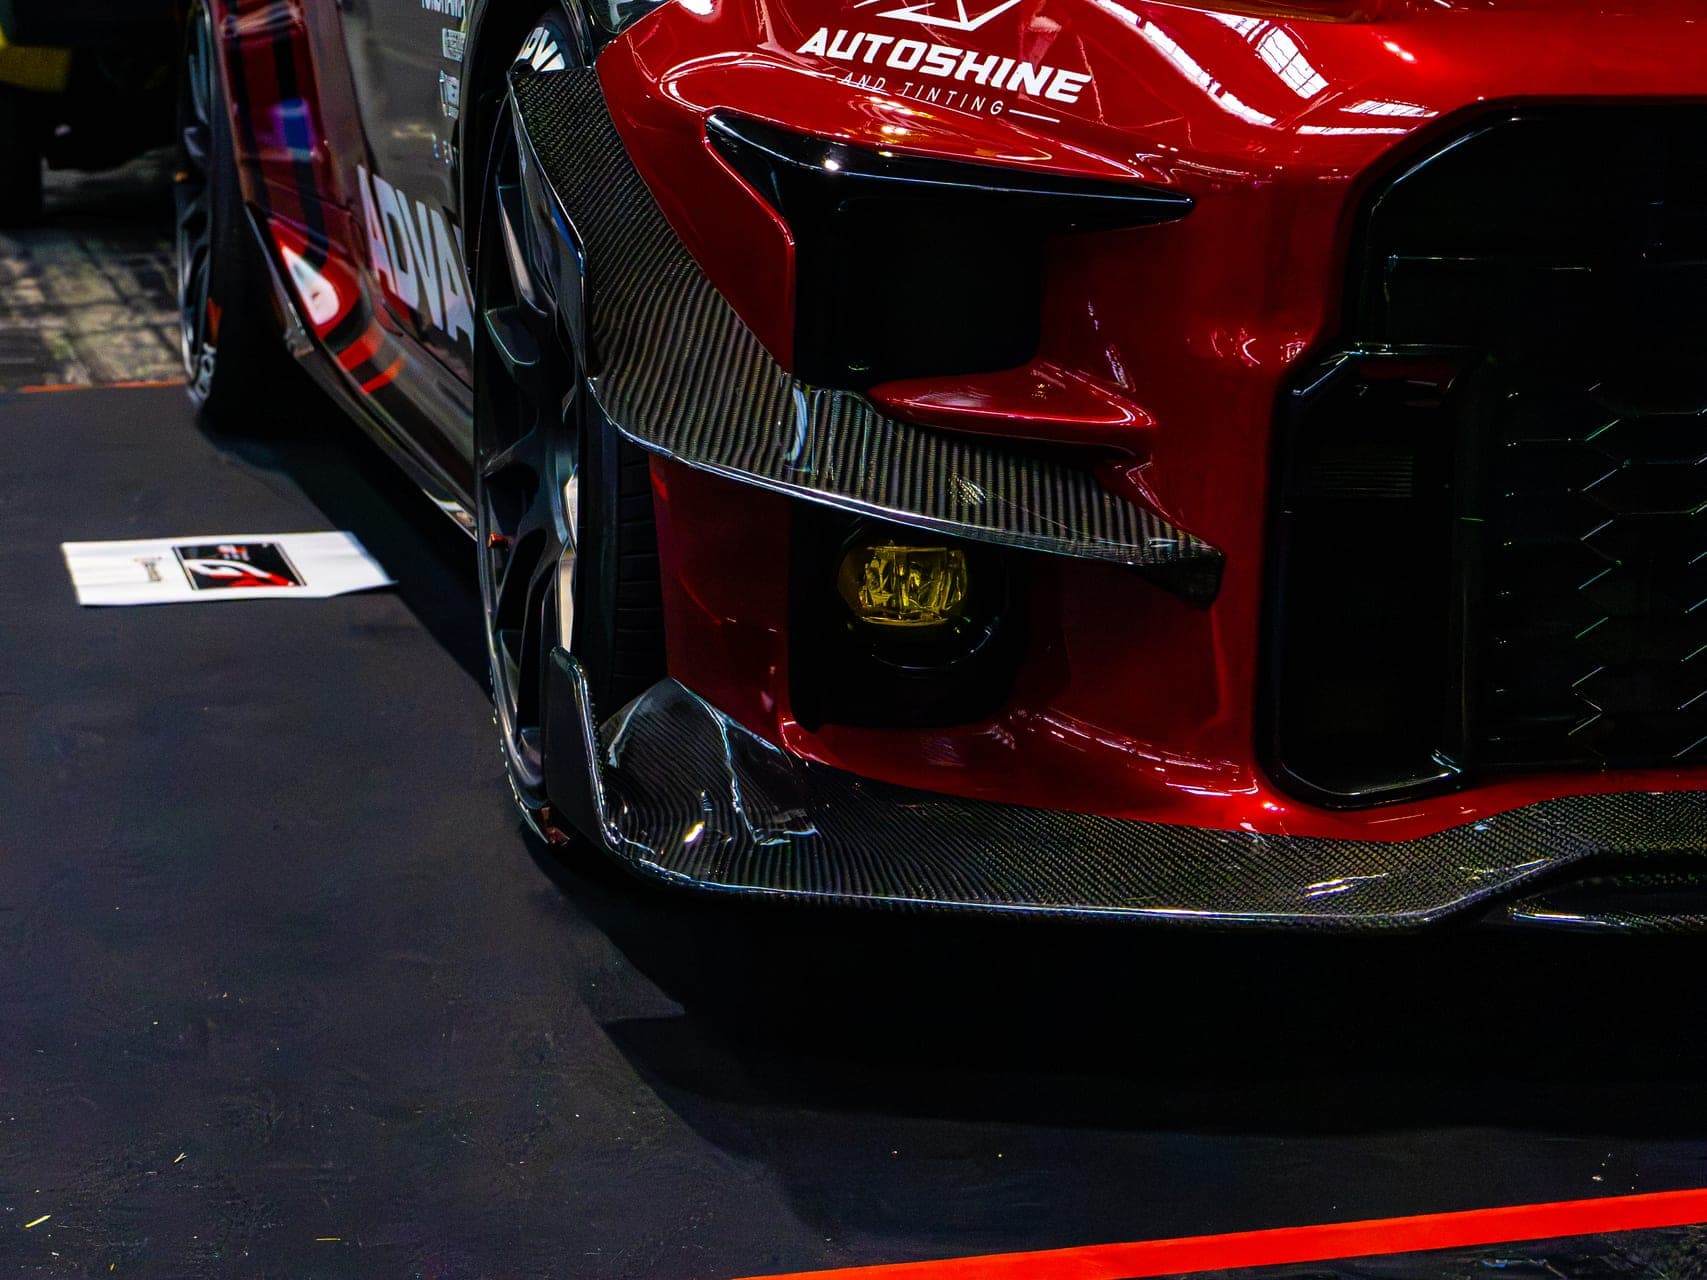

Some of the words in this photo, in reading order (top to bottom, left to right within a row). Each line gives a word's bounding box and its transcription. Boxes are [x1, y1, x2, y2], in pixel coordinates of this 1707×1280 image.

[796, 26, 1092, 104] AUTOSHINE
[840, 72, 887, 91] AND
[901, 82, 1005, 115] TINTING
[357, 163, 475, 352] ADVA
